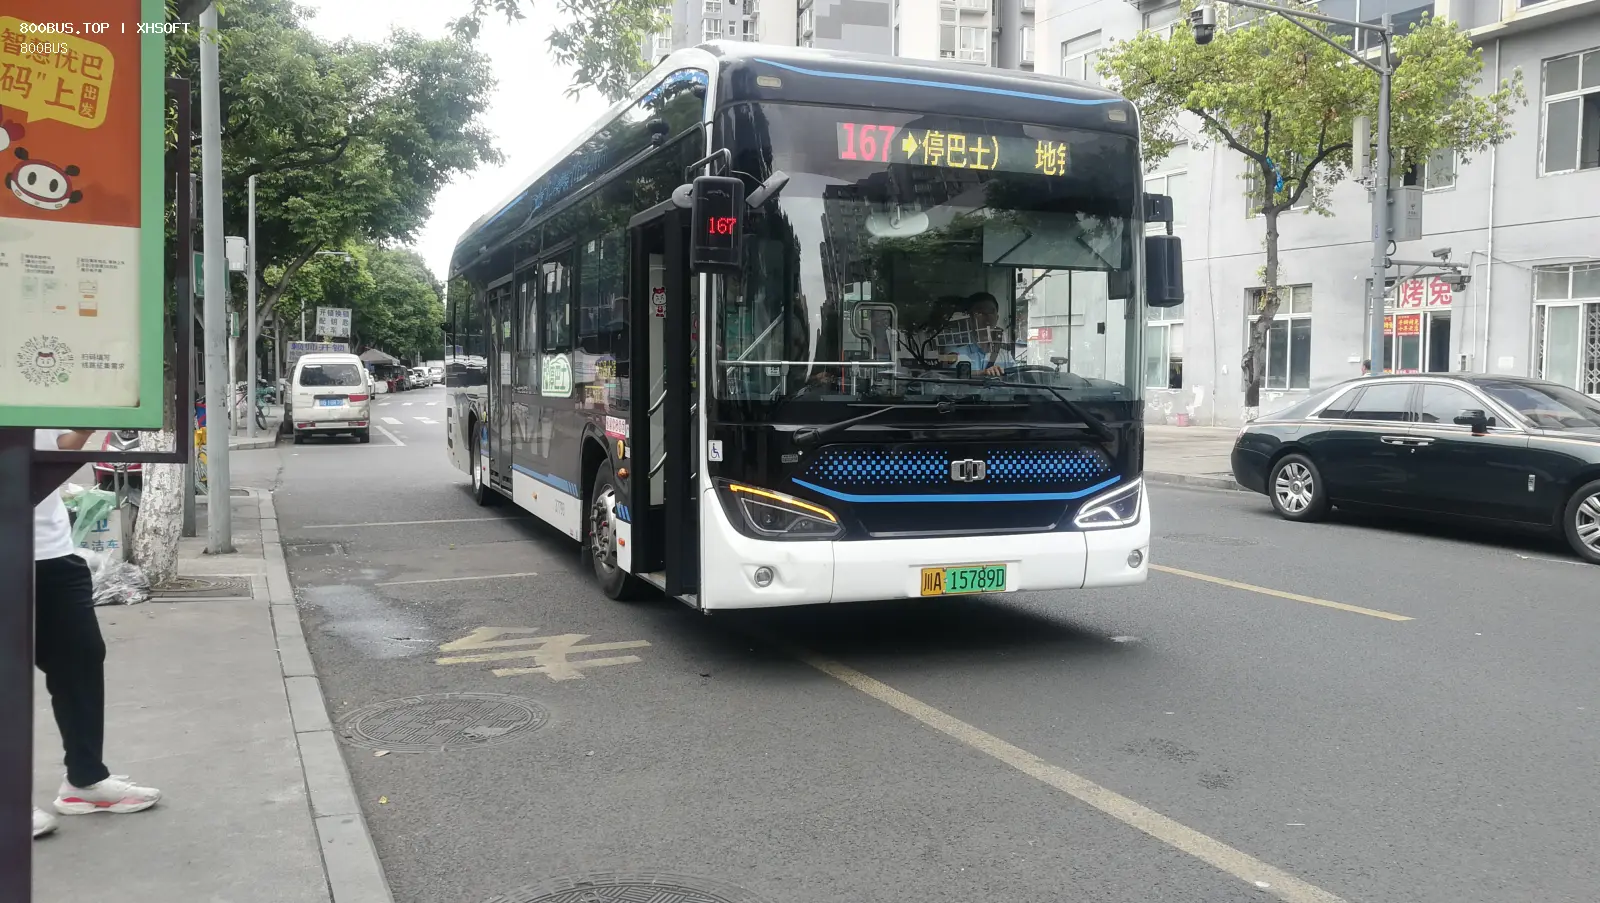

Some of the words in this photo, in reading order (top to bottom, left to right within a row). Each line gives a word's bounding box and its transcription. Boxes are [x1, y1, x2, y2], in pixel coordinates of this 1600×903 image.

[841, 122, 896, 162] 167
[709, 216, 737, 235] 167
[1401, 275, 1453, 308] 烤兔
